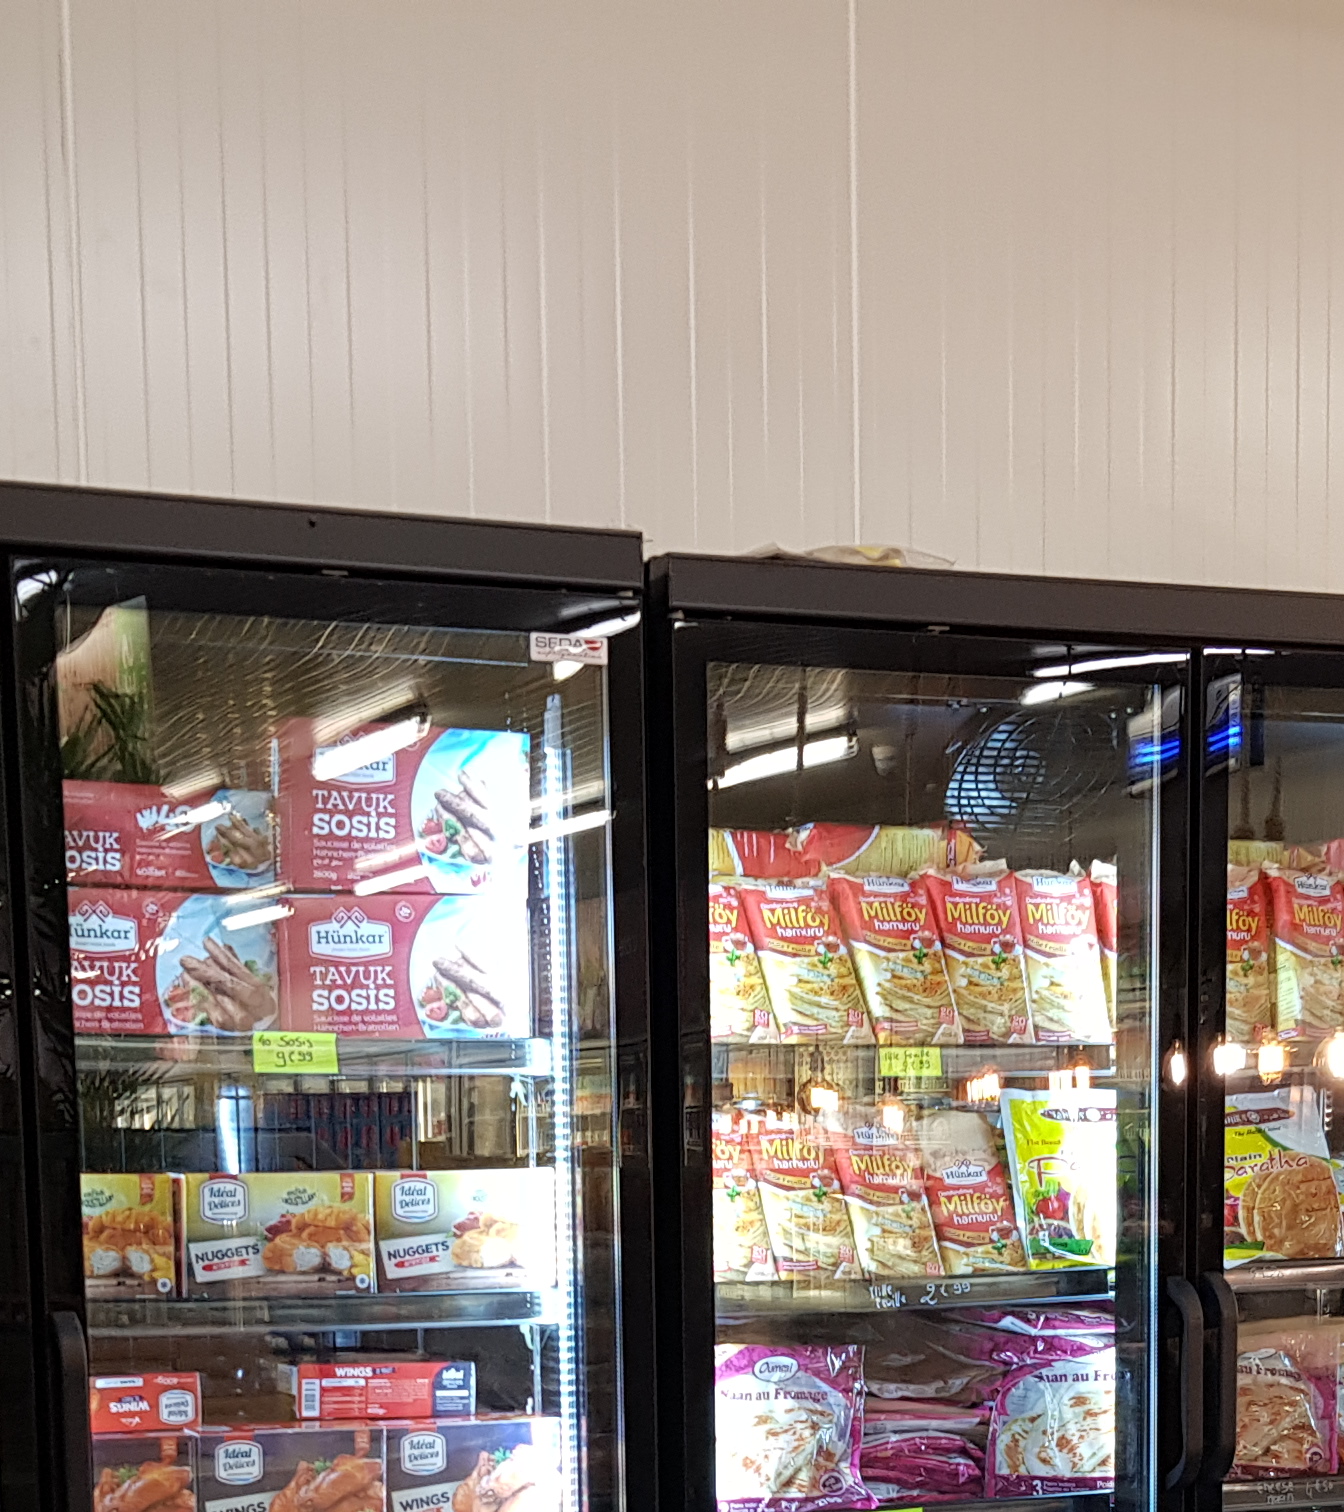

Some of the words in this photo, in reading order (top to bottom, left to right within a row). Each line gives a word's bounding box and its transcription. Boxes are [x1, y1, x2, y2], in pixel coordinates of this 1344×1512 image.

[313, 788, 396, 816] TAVUK
[761, 905, 831, 931] Milföy
[860, 897, 927, 925] Milföy
[946, 899, 1012, 928] Milföy
[1026, 901, 1089, 929] Milföy
[1294, 903, 1343, 932] Milföy
[315, 926, 386, 948] Hünkar
[309, 966, 395, 988] TAVUK
[939, 1194, 1004, 1218] Milföy
[193, 1242, 261, 1266] NUGGETS
[386, 1240, 451, 1264] NUGGETS
[773, 1387, 829, 1403] Fromage
